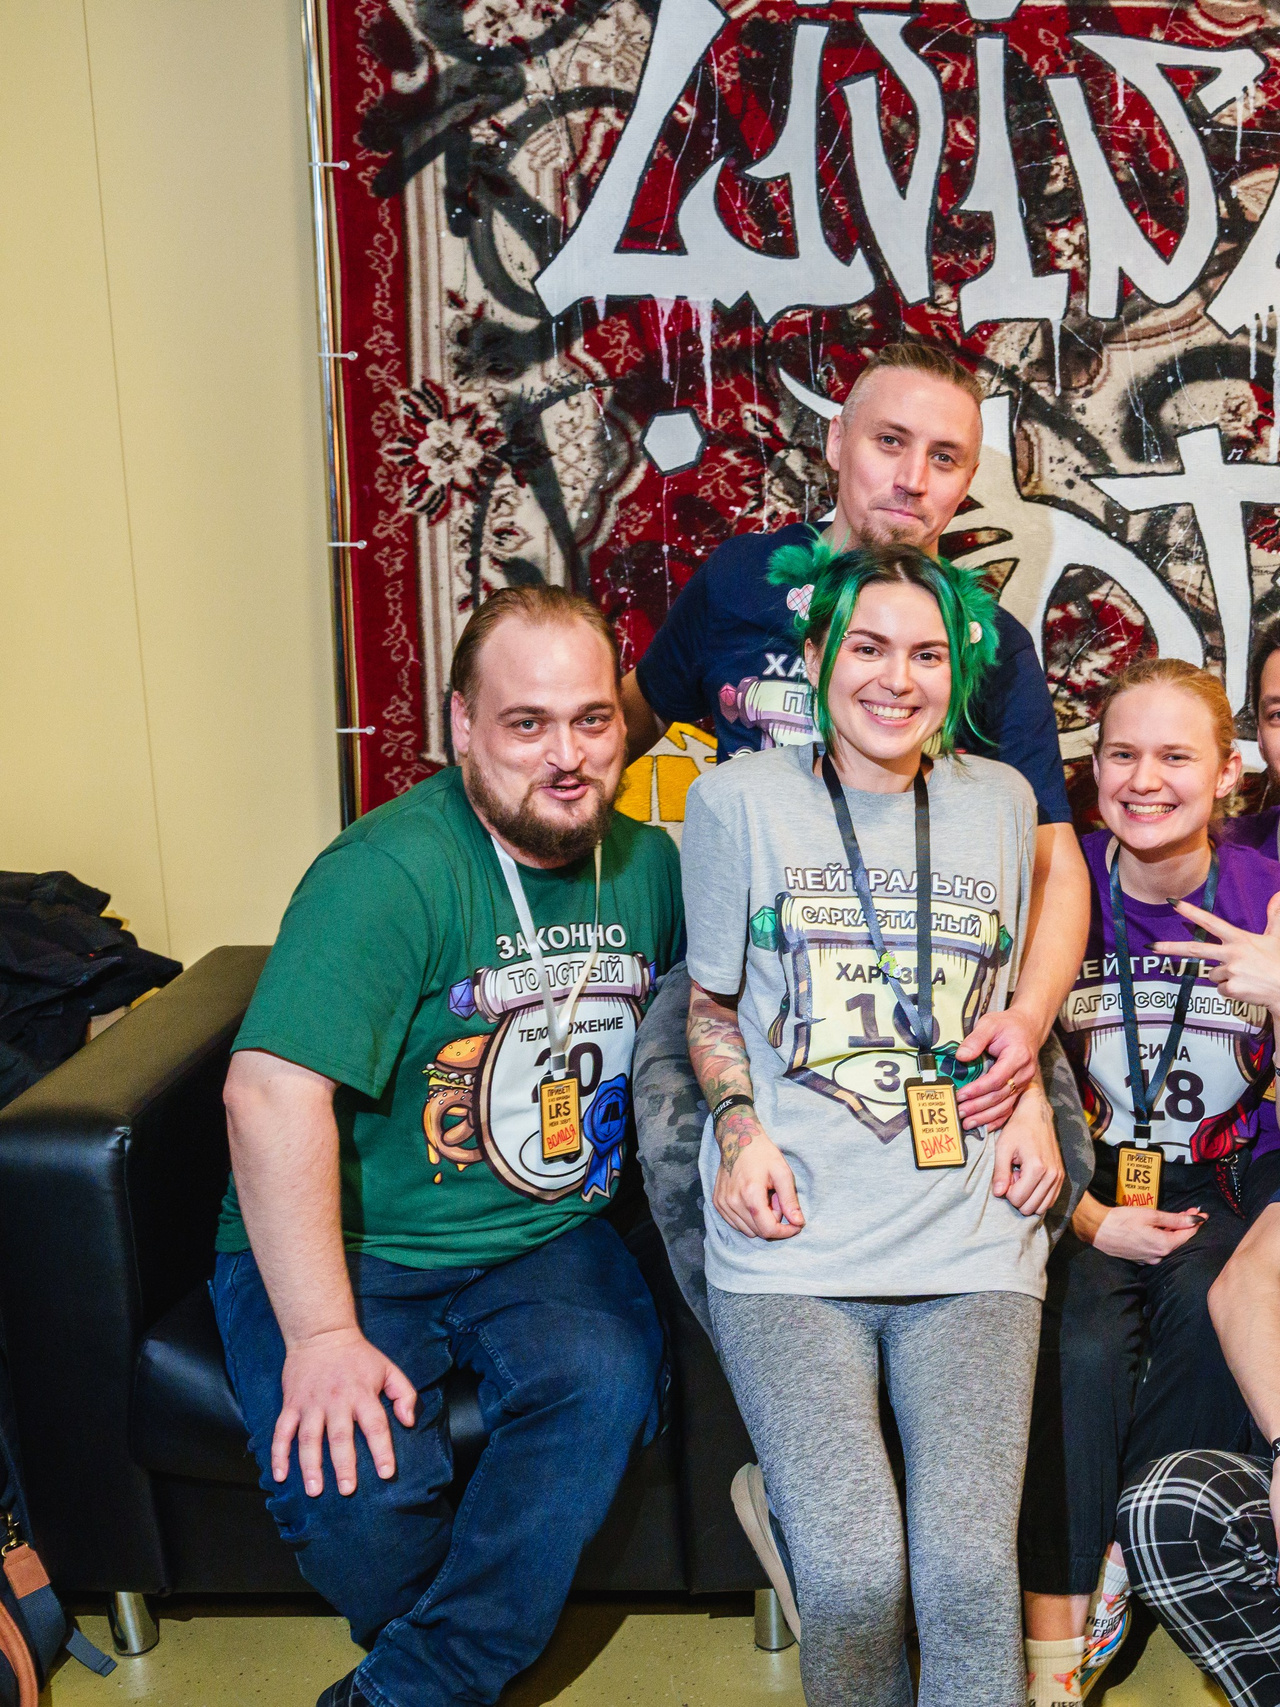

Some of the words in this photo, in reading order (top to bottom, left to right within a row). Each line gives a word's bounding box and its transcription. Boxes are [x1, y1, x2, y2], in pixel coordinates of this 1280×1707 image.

[785, 863, 997, 905] НЕЙРАЬНО
[802, 906, 981, 939] САРКАСТИНЫЙ
[496, 922, 627, 960] ЗАКОННО
[508, 955, 624, 994] ТОЛСТЫЙ
[836, 962, 947, 986] ХАРЗА
[518, 1016, 624, 1042] ТЕЛОЖЕНИЕ
[1138, 1043, 1192, 1062] СИА
[549, 1101, 571, 1119] LRS
[920, 1108, 948, 1126] LRS
[920, 1134, 957, 1159] ВИКА
[1126, 1168, 1151, 1184] LRS
